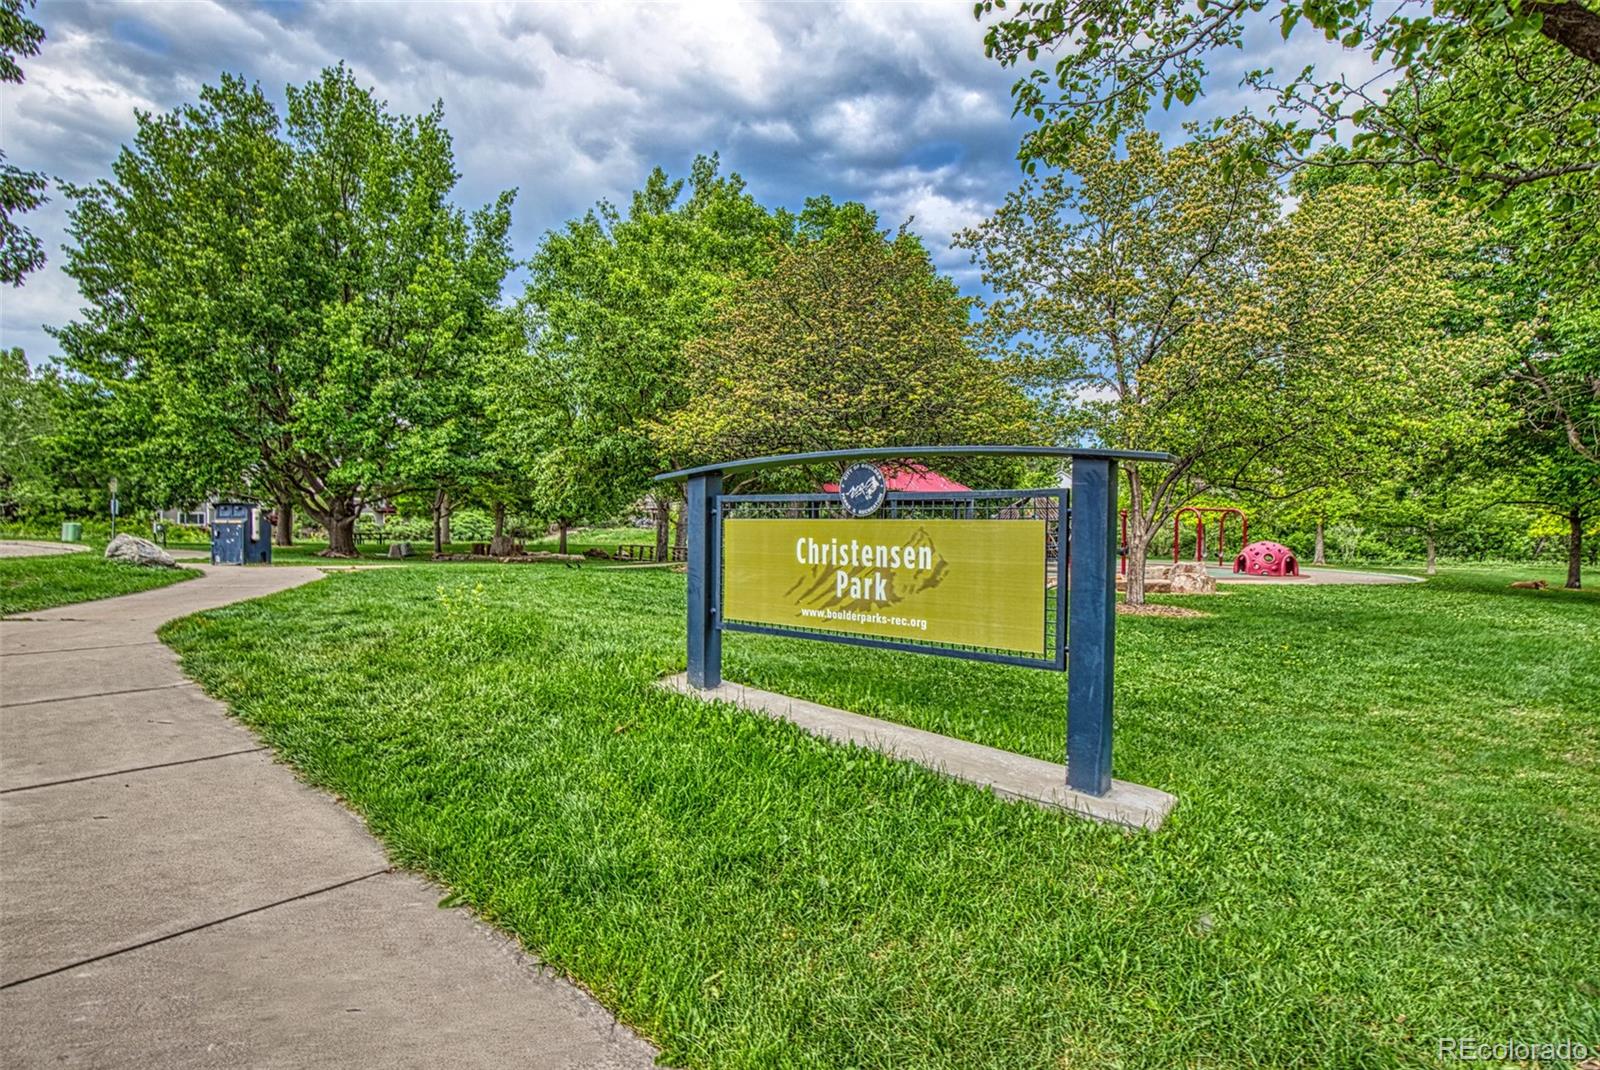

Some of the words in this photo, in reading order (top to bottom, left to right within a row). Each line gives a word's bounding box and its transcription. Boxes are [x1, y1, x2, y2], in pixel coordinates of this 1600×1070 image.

[796, 537, 932, 570] Christensen
[836, 570, 887, 601] Park
[801, 608, 927, 630] www.boulderparks-rec.org
